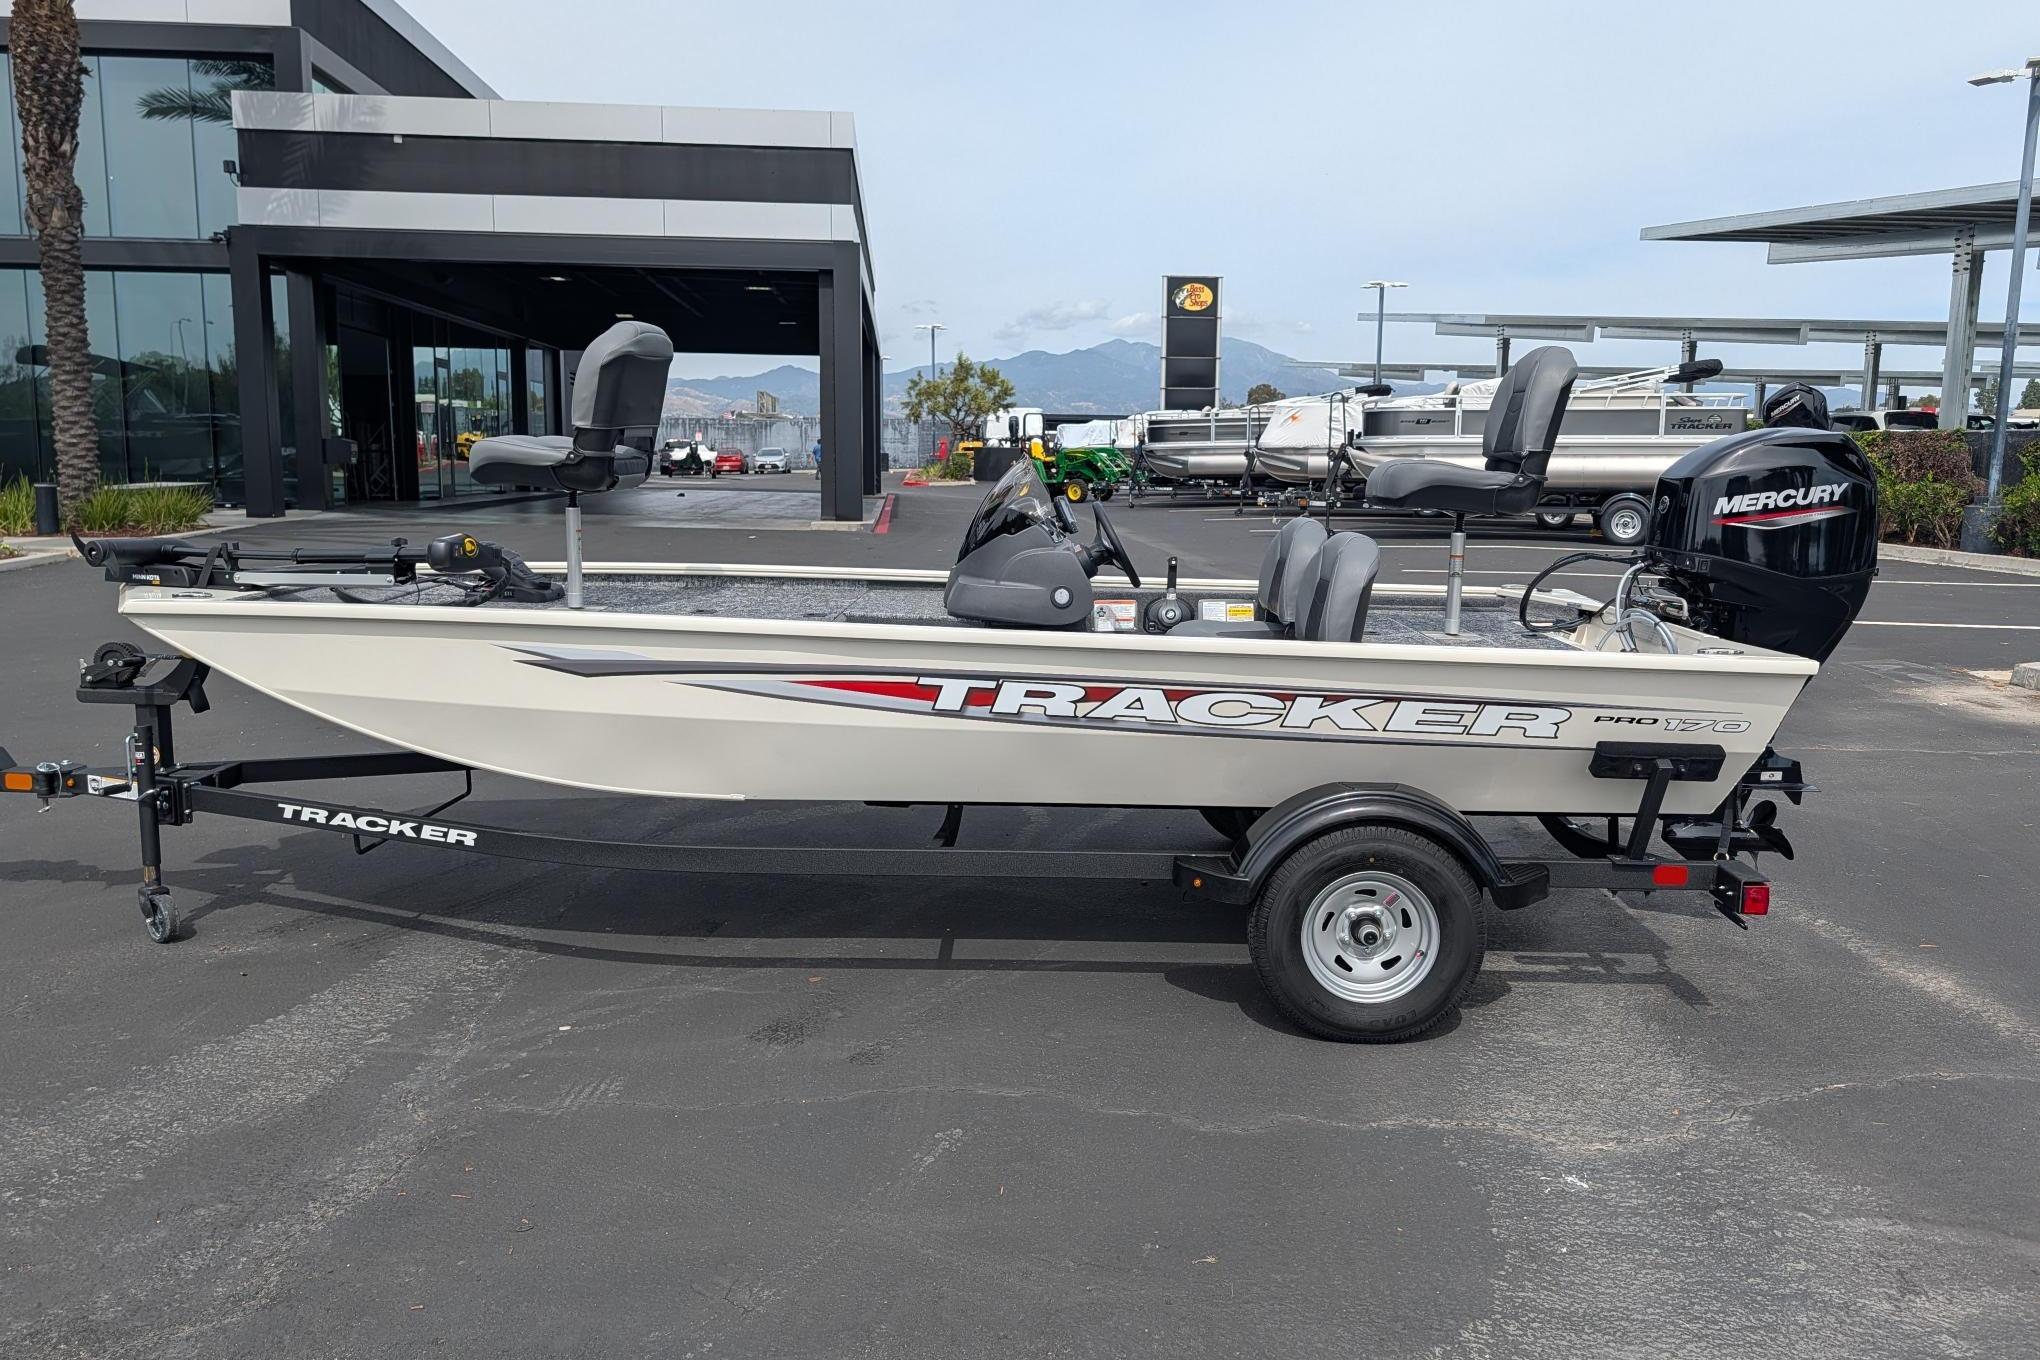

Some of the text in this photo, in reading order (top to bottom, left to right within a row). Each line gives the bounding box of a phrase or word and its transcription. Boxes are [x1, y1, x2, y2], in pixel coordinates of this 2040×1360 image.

[1190, 285, 1205, 293] Bass
[1189, 299, 1208, 308] Shops
[1770, 394, 1801, 417] MERCURY
[1713, 482, 1849, 515] MERCURY
[915, 675, 1573, 739] TRACKER
[1594, 716, 1751, 733] PRO 170
[278, 803, 478, 847] TRACKER
